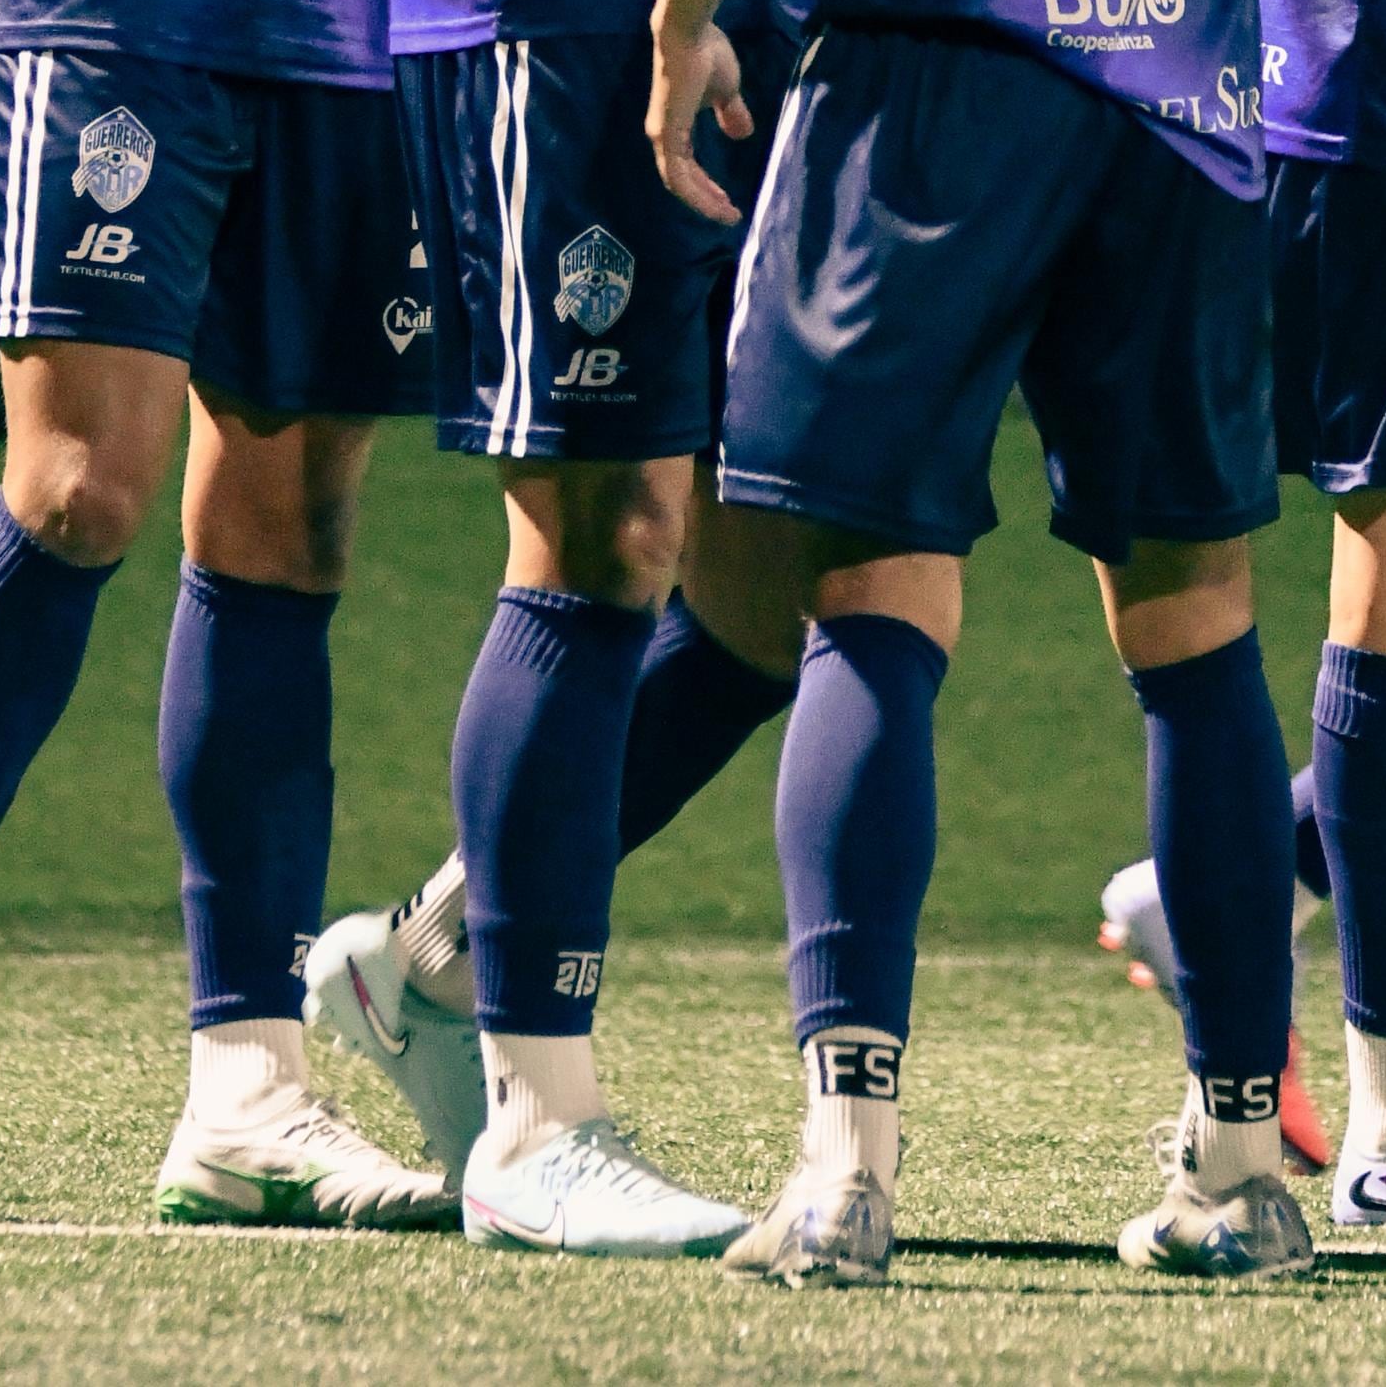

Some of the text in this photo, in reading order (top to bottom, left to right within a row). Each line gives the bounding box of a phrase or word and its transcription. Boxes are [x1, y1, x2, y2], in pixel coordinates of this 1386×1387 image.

[84, 123, 151, 164] GUERREROS
[65, 223, 140, 265] JB
[60, 264, 146, 284] TEXTILESJB.COM
[553, 348, 621, 387] JB
